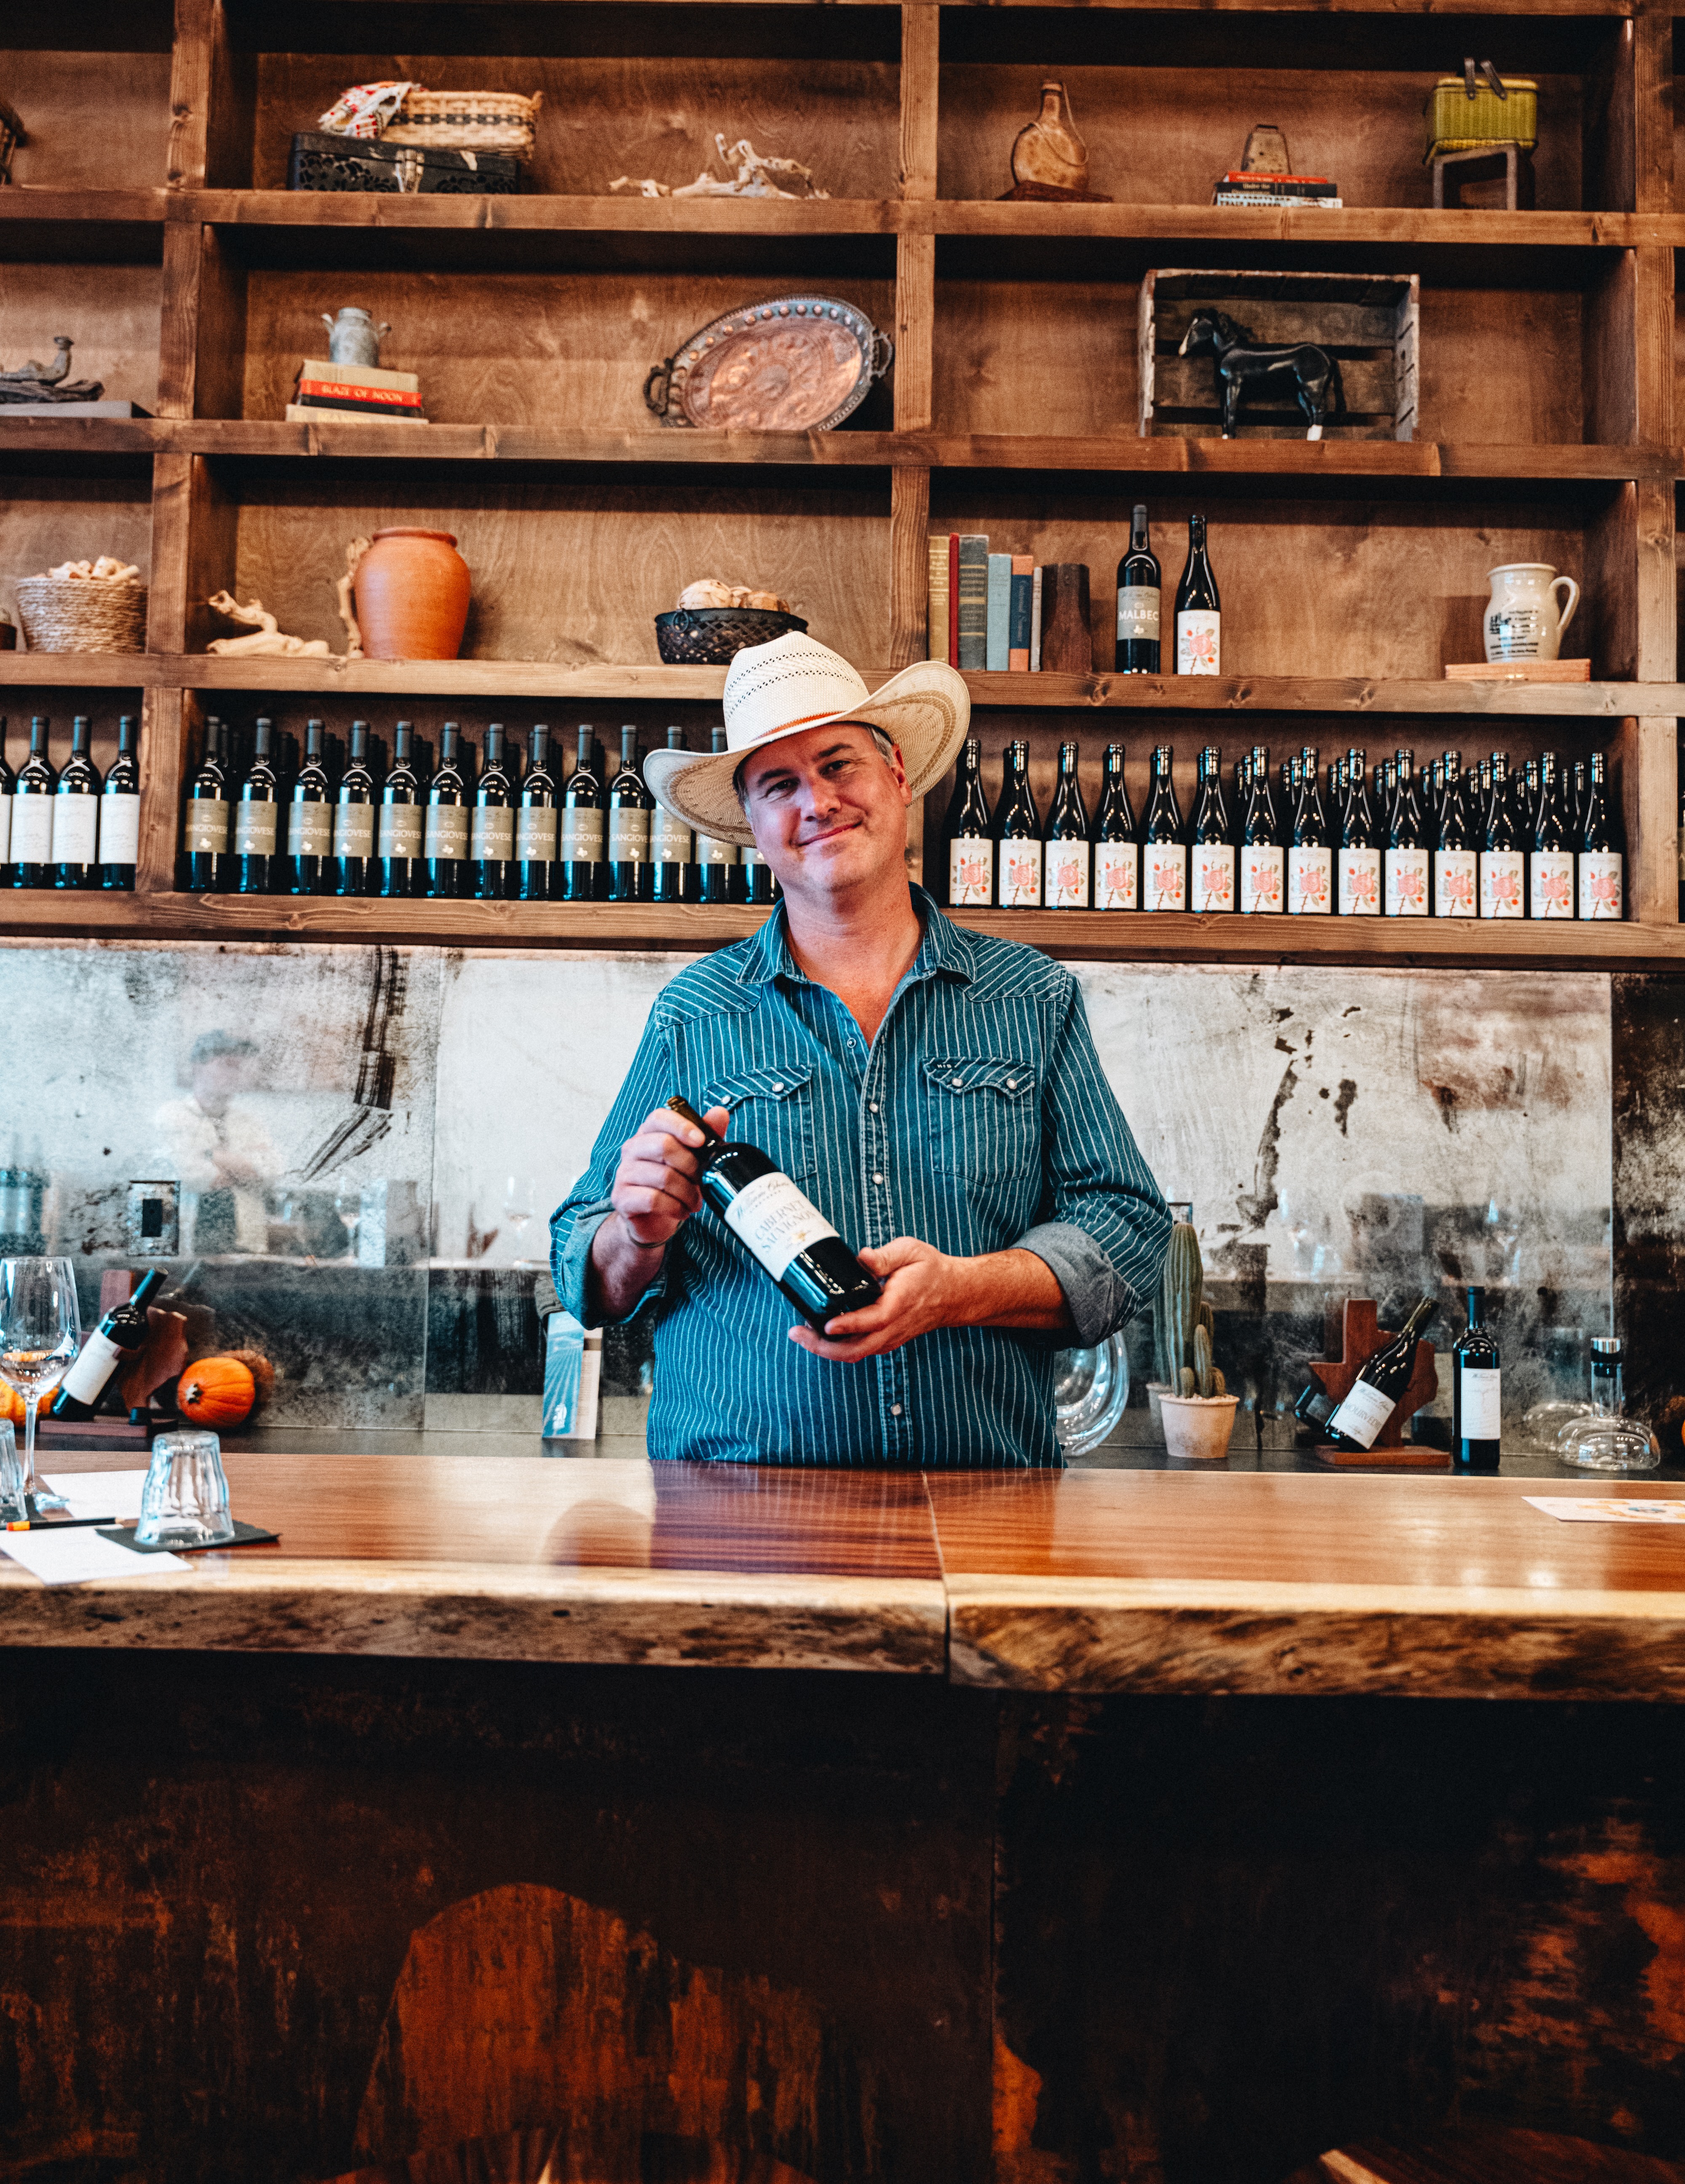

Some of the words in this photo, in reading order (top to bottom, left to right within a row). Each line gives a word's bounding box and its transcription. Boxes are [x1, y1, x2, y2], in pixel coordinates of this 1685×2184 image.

[1119, 610, 1158, 621] MALBEC
[755, 1200, 804, 1240] CABERNET
[762, 1210, 816, 1253] SAUVIGNON
